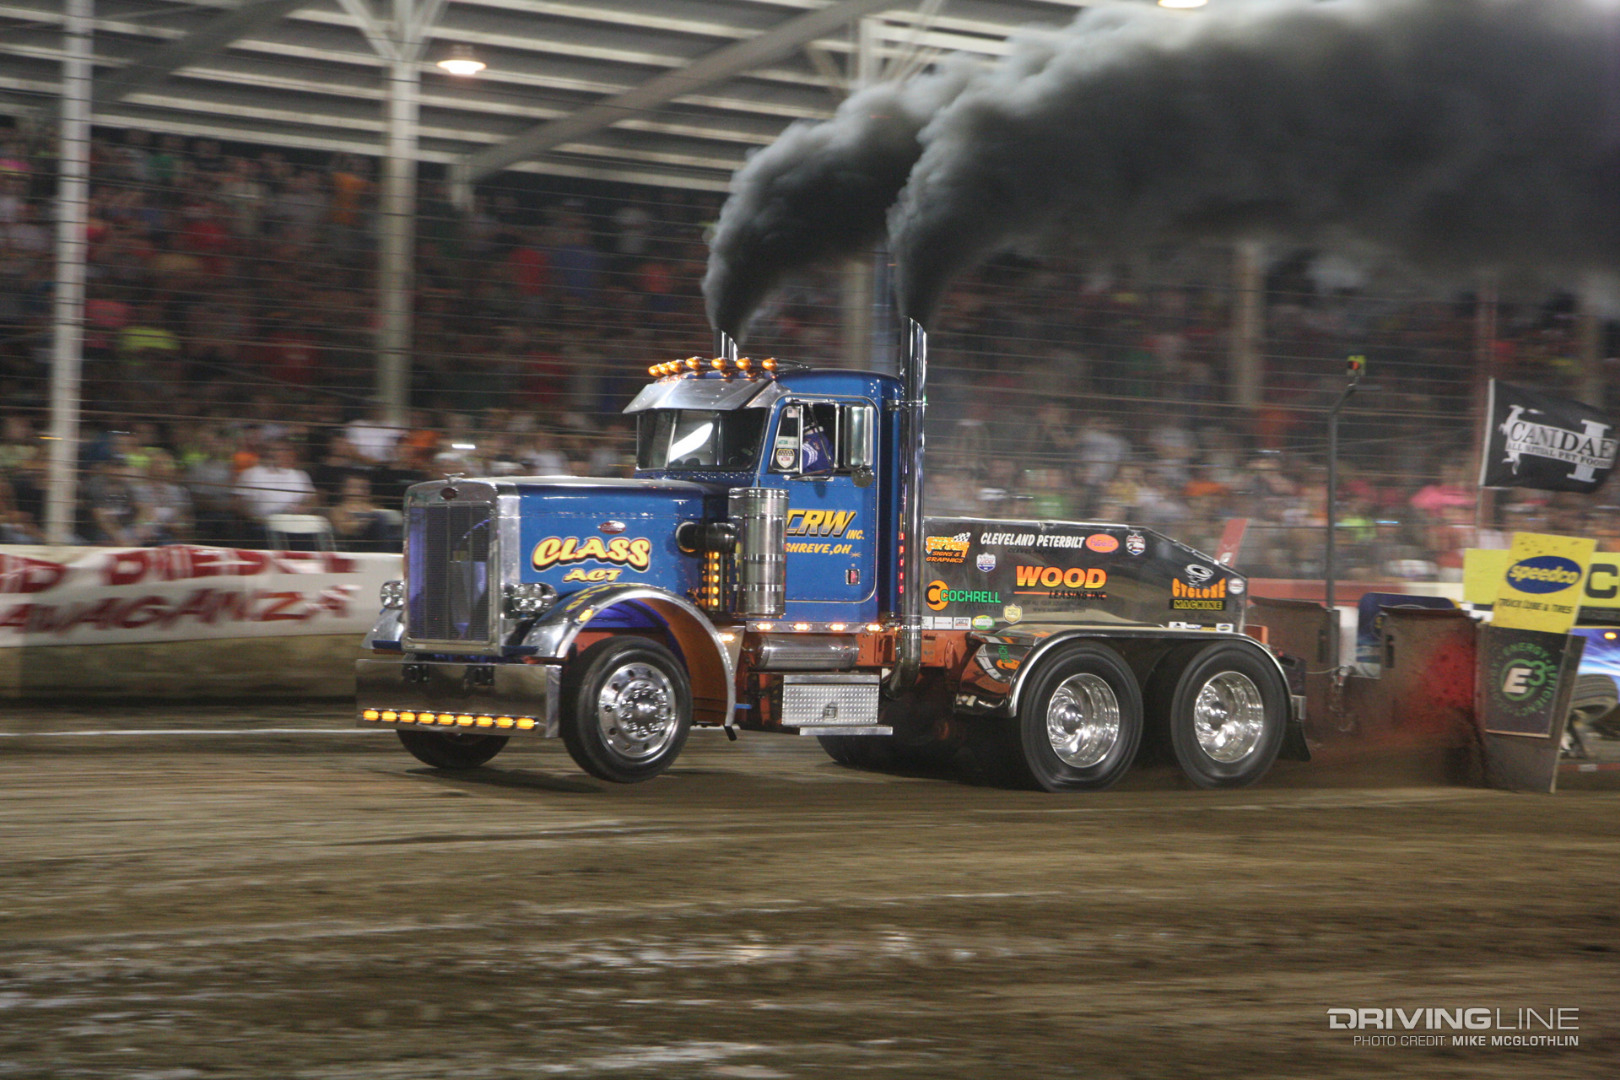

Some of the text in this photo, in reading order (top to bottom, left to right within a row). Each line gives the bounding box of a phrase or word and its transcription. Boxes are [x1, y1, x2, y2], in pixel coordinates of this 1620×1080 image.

[786, 509, 857, 538] CRW
[845, 529, 865, 540] INC.
[980, 532, 1035, 546] CLEVELAND
[1036, 535, 1086, 549] PETERBILT
[531, 536, 651, 572] CLASS
[925, 556, 965, 564] GRAPHICS
[561, 567, 623, 583] ACT
[1015, 564, 1108, 589] WOOD
[1508, 562, 1579, 585] speedco
[1048, 589, 1088, 600] LEASING
[1171, 577, 1227, 599] CYCLONE
[939, 589, 1002, 604] COCHRELL
[1173, 600, 1224, 610] MACHINE
